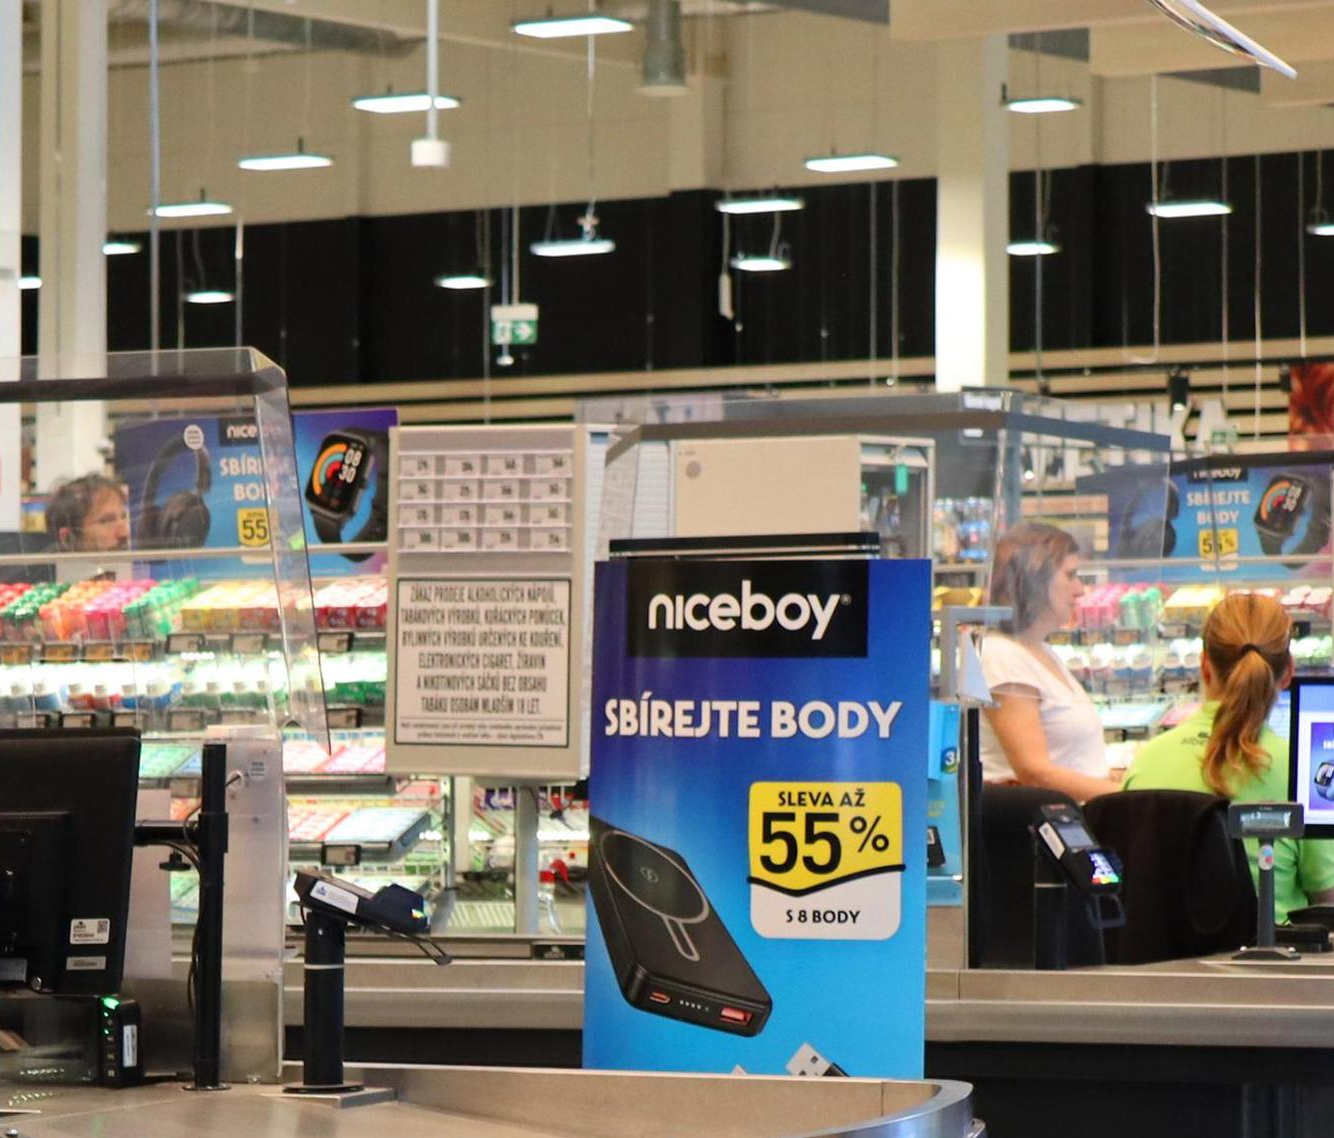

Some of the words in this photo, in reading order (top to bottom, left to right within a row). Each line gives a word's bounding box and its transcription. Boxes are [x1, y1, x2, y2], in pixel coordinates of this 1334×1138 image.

[227, 425, 257, 439] nice
[220, 454, 262, 477] SBÍR
[344, 449, 362, 467] 08
[338, 465, 356, 483] 30
[647, 580, 840, 640] niceboy
[605, 691, 760, 738] SBÍREJTE
[771, 701, 902, 738] BODY
[778, 791, 834, 807] SLEVA
[839, 788, 865, 807] AŽ
[759, 812, 889, 875] 55%
[786, 910, 793, 925] S
[797, 910, 807, 925] 8
[811, 910, 861, 925] BODY
